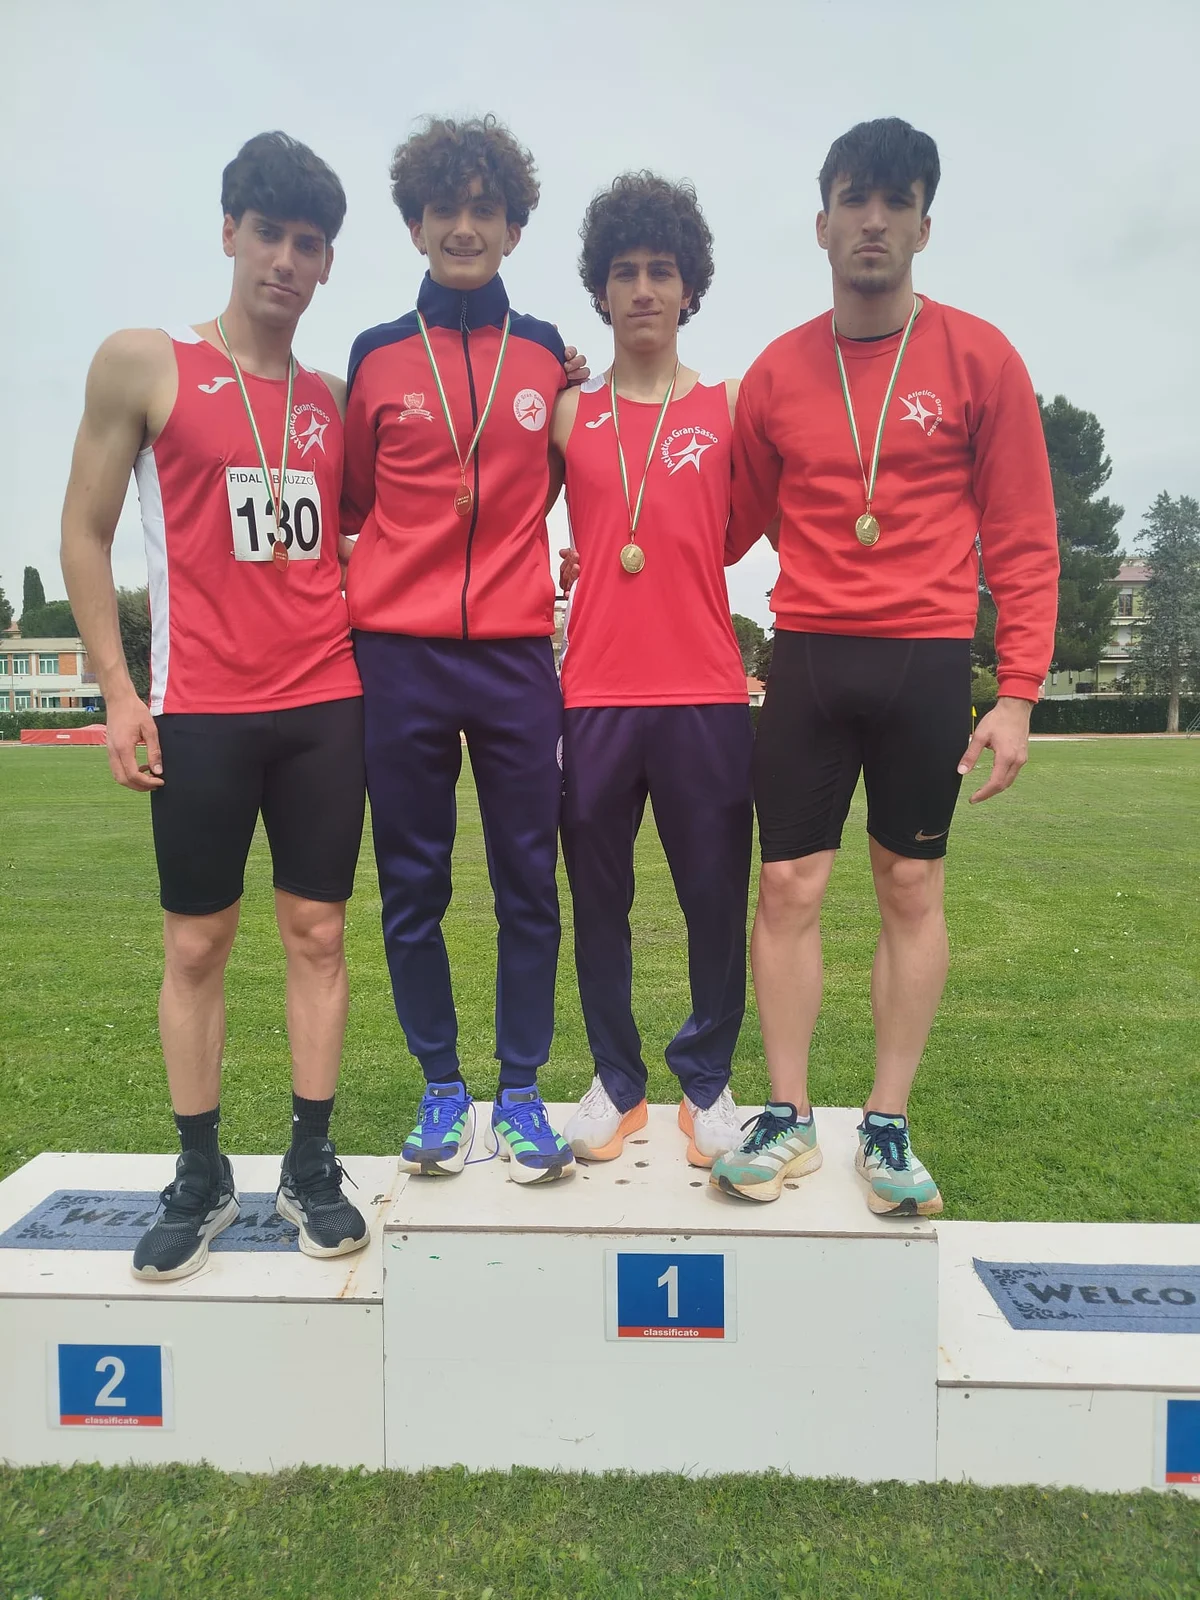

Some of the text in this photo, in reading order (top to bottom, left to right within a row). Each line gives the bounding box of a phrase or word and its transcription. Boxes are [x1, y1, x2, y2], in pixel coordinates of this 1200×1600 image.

[907, 390, 936, 400] Atletica
[229, 473, 263, 484] FIDAL
[236, 497, 320, 552] 130
[657, 1265, 679, 1318] 1
[1023, 1282, 1197, 1306] WELCO
[643, 1328, 700, 1338] classificato
[94, 1355, 127, 1407] 2
[84, 1416, 139, 1425] classificato
